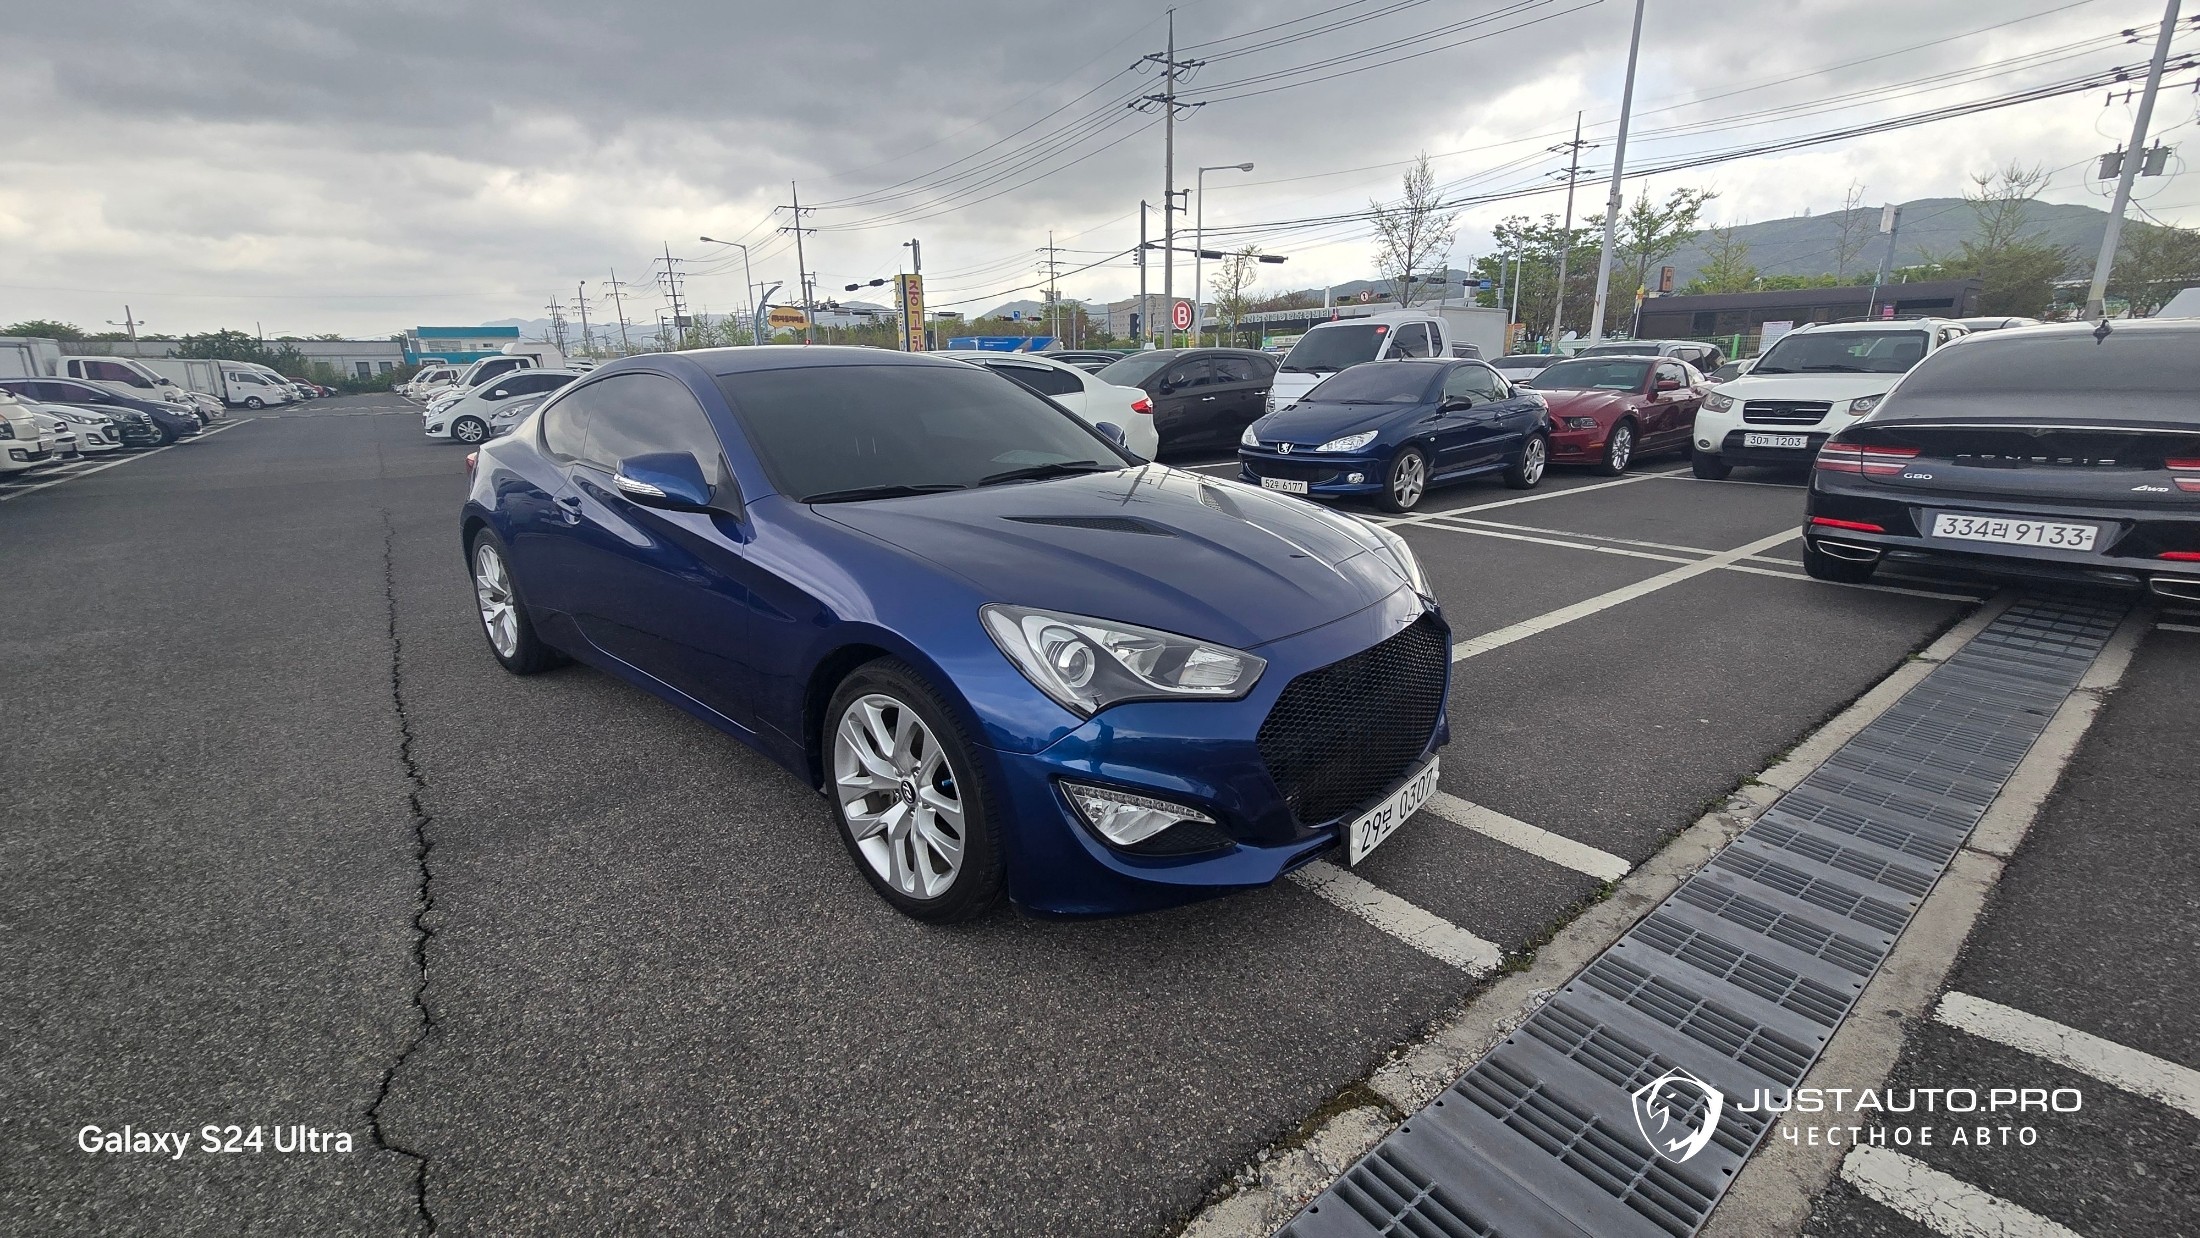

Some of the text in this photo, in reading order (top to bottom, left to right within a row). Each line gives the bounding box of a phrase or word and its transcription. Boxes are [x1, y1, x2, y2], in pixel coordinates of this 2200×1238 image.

[908, 279, 924, 352] 중고차
[1177, 306, 1188, 325] B
[1775, 436, 1801, 447] 1203
[1282, 481, 1303, 491] 6177
[1942, 517, 2087, 547] 334러 9133
[1361, 766, 1434, 854] 29보 0307
